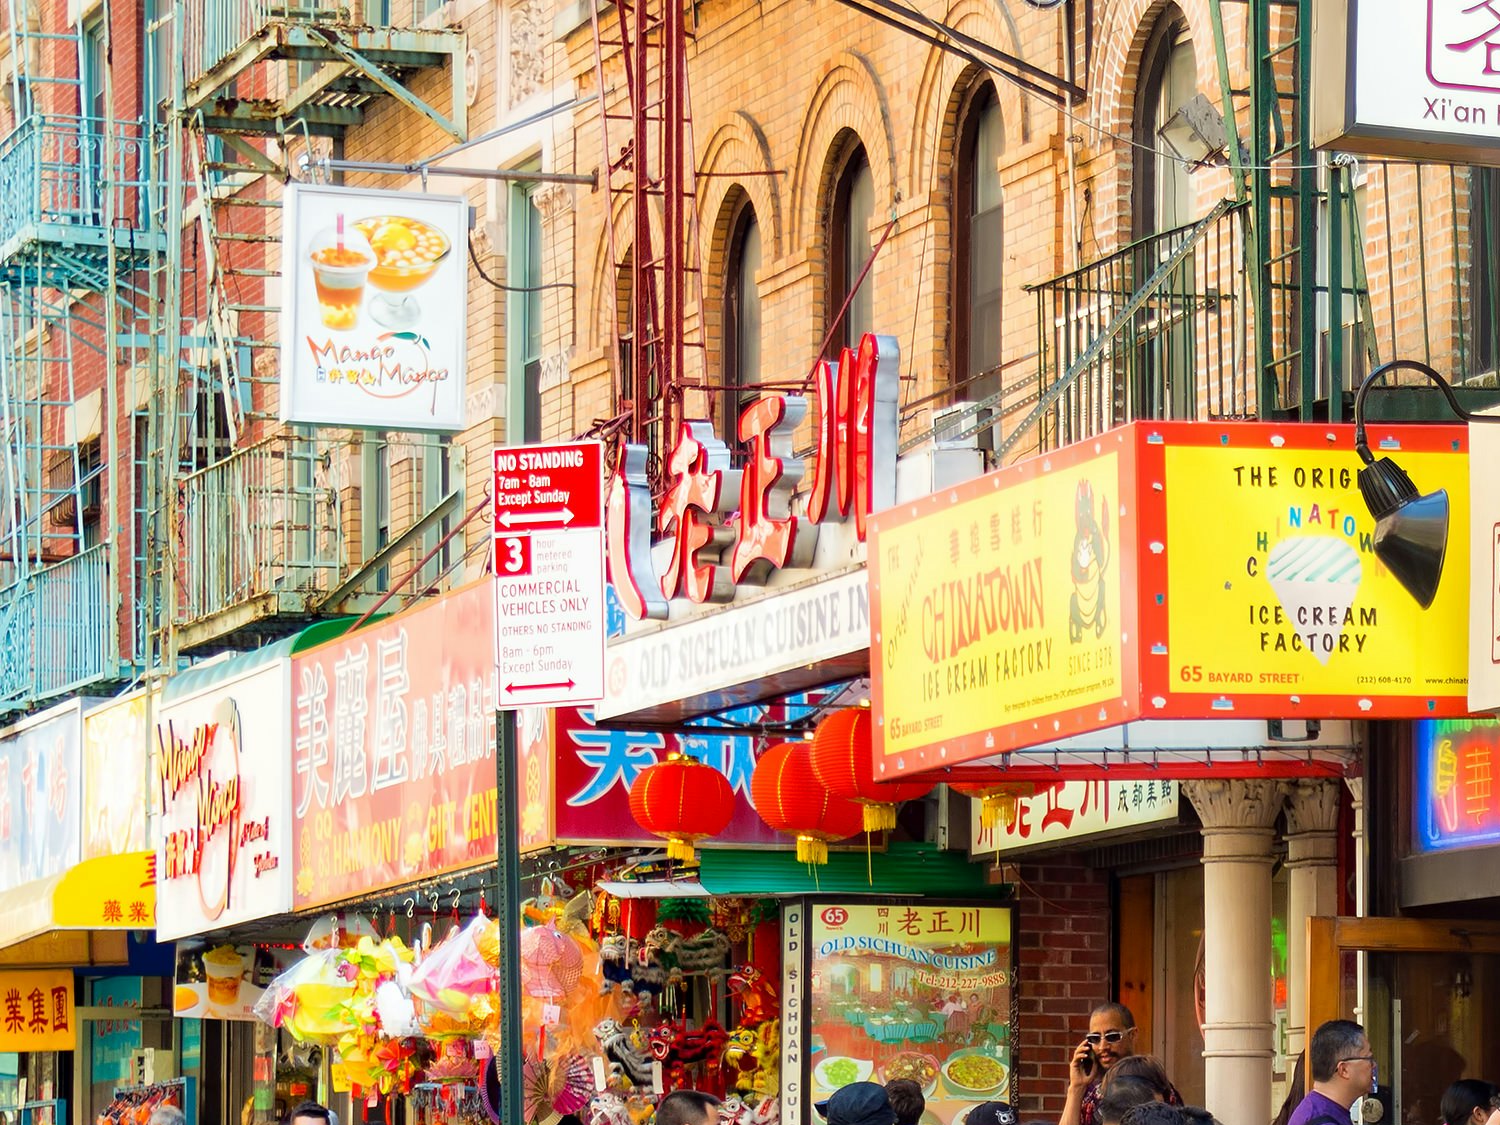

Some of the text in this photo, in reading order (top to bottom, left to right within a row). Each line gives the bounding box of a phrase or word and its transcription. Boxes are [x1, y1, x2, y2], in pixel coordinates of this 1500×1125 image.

[1423, 97, 1486, 125] Xi'an
[305, 335, 395, 369] Mango
[498, 451, 584, 472] NO STANDING
[658, 332, 879, 604] 老正川
[498, 475, 520, 489] 7am
[528, 473, 550, 487] 8am
[1233, 466, 1277, 488] THE
[498, 489, 570, 507] Except Sunday
[536, 538, 556, 549] hour
[504, 538, 523, 572] 3
[536, 549, 572, 561] metered
[536, 561, 569, 575] parking
[501, 579, 580, 598] COMMERCIAL
[502, 597, 589, 616] VEHICLES ONLY
[921, 556, 1045, 664] CHINATOWN
[1250, 605, 1377, 627] ICE CREAM
[502, 620, 592, 636] OTHERS NO STANDING
[639, 643, 672, 689] OLD
[678, 619, 757, 681] SICHUAN
[765, 590, 840, 656] CUISINE
[1260, 632, 1367, 653] FACTORY
[503, 646, 523, 658] 8am
[532, 644, 554, 659] 6pm
[1068, 645, 1113, 677] SINCE 1978
[503, 660, 573, 674] Except Sunday
[922, 637, 1053, 702] ICE CREAM FACTORY
[1180, 665, 1202, 684] 65
[1208, 672, 1253, 684] BAYARD
[1259, 672, 1299, 685] STREET
[1356, 675, 1377, 685] (212)
[1378, 675, 1412, 685] 608-4170
[296, 628, 410, 819] 美麗屋
[890, 714, 943, 740] 65 BAYARD STREET
[333, 817, 402, 875] HARMONY
[427, 800, 457, 853] GIFT
[825, 908, 845, 923] 65
[877, 907, 889, 936] 四川
[896, 907, 981, 938] 老正川
[787, 913, 799, 951] OLD
[820, 936, 997, 971] OLD SICHUAN CUISINE
[918, 969, 1007, 990] Tel: 212-227-9888
[787, 970, 799, 1063] SICHUAN
